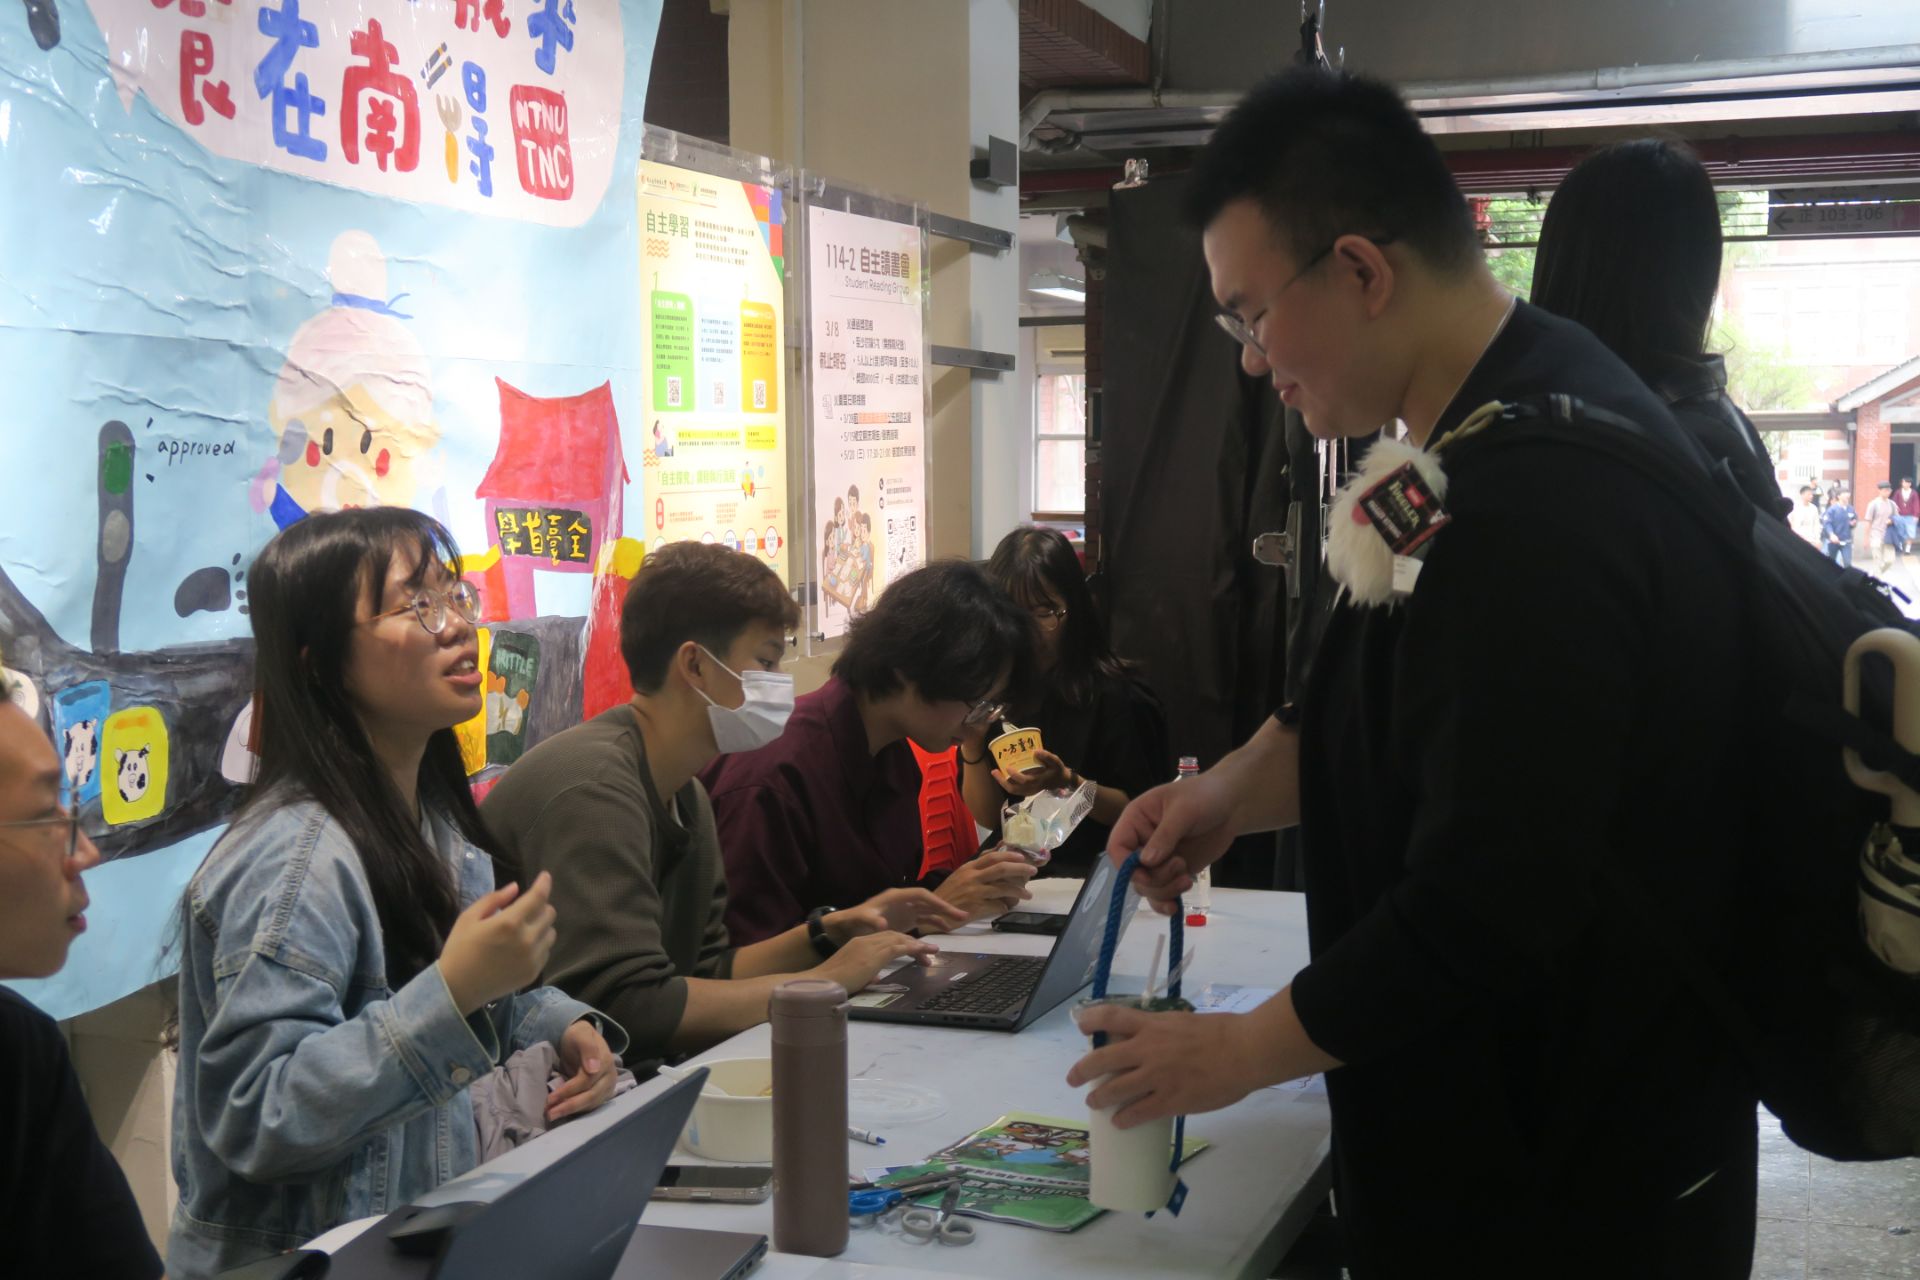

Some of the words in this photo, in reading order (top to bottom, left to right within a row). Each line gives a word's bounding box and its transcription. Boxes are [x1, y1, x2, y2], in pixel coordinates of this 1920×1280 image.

[516, 99, 565, 135] NTNU
[521, 139, 570, 189] TNC
[646, 209, 689, 239] 自主學習
[826, 243, 856, 271] 114-2
[845, 275, 869, 289] Student
[869, 278, 892, 295] Reading
[825, 320, 840, 337] 3/8
[158, 440, 235, 467] approved
